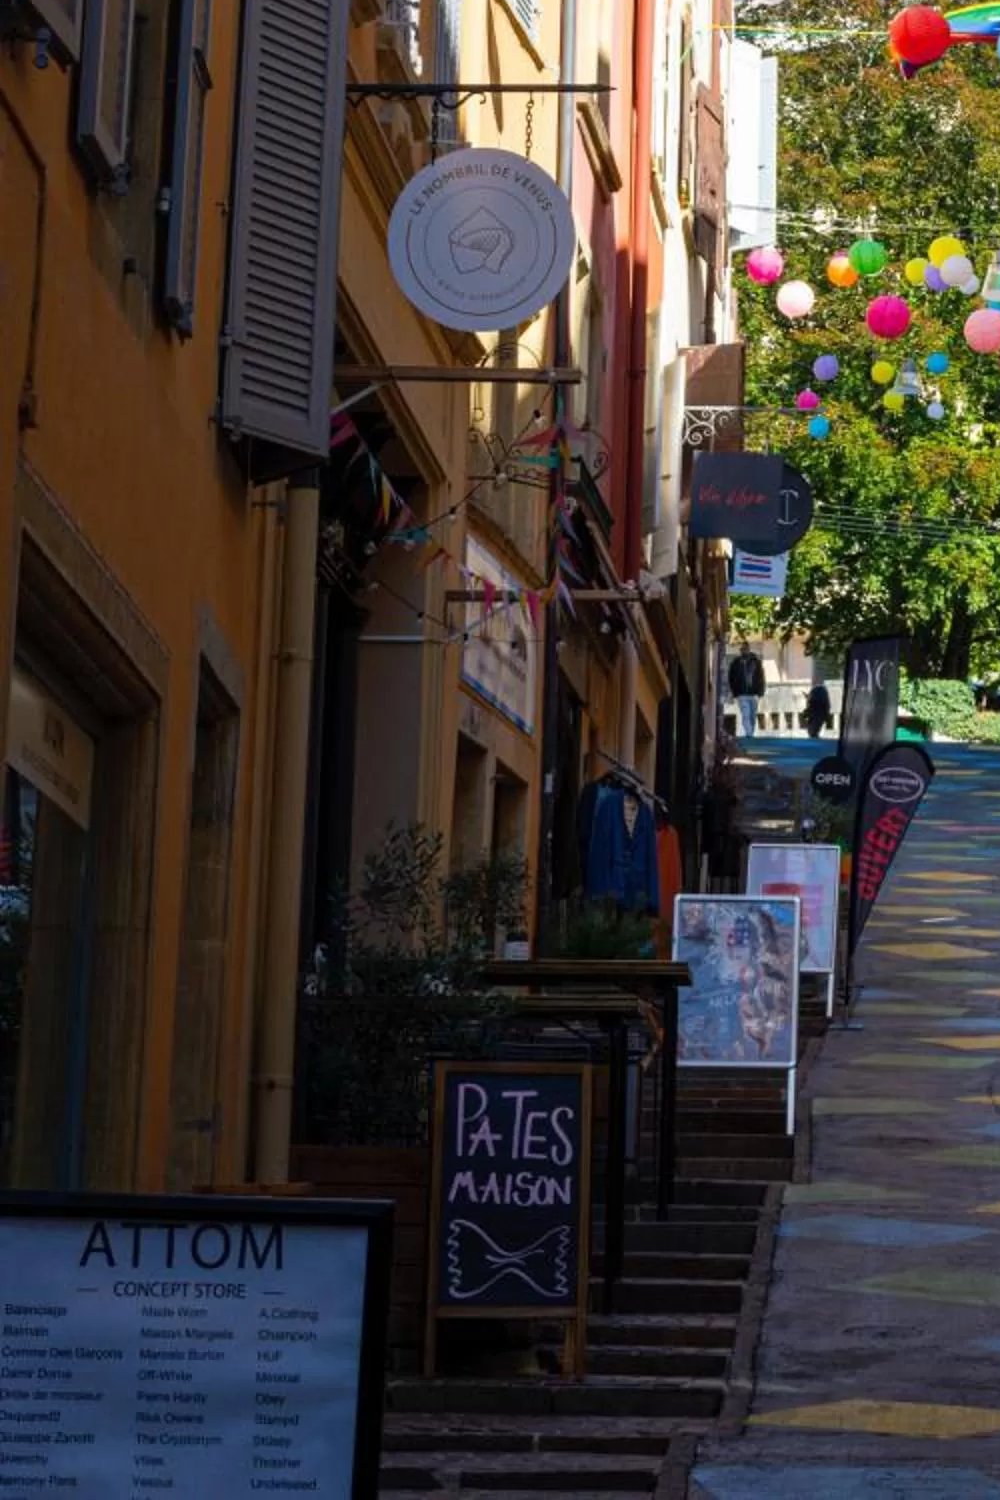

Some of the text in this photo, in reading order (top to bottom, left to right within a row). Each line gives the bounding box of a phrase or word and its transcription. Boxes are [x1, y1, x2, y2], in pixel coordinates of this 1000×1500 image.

[409, 198, 426, 216] LE
[490, 164, 510, 178] DE
[815, 772, 851, 787] OPEN
[455, 1083, 575, 1167] PATES
[447, 1169, 573, 1208] MAISON
[79, 1222, 284, 1271] ATTOM
[113, 1280, 247, 1299] CONCEPT STORE
